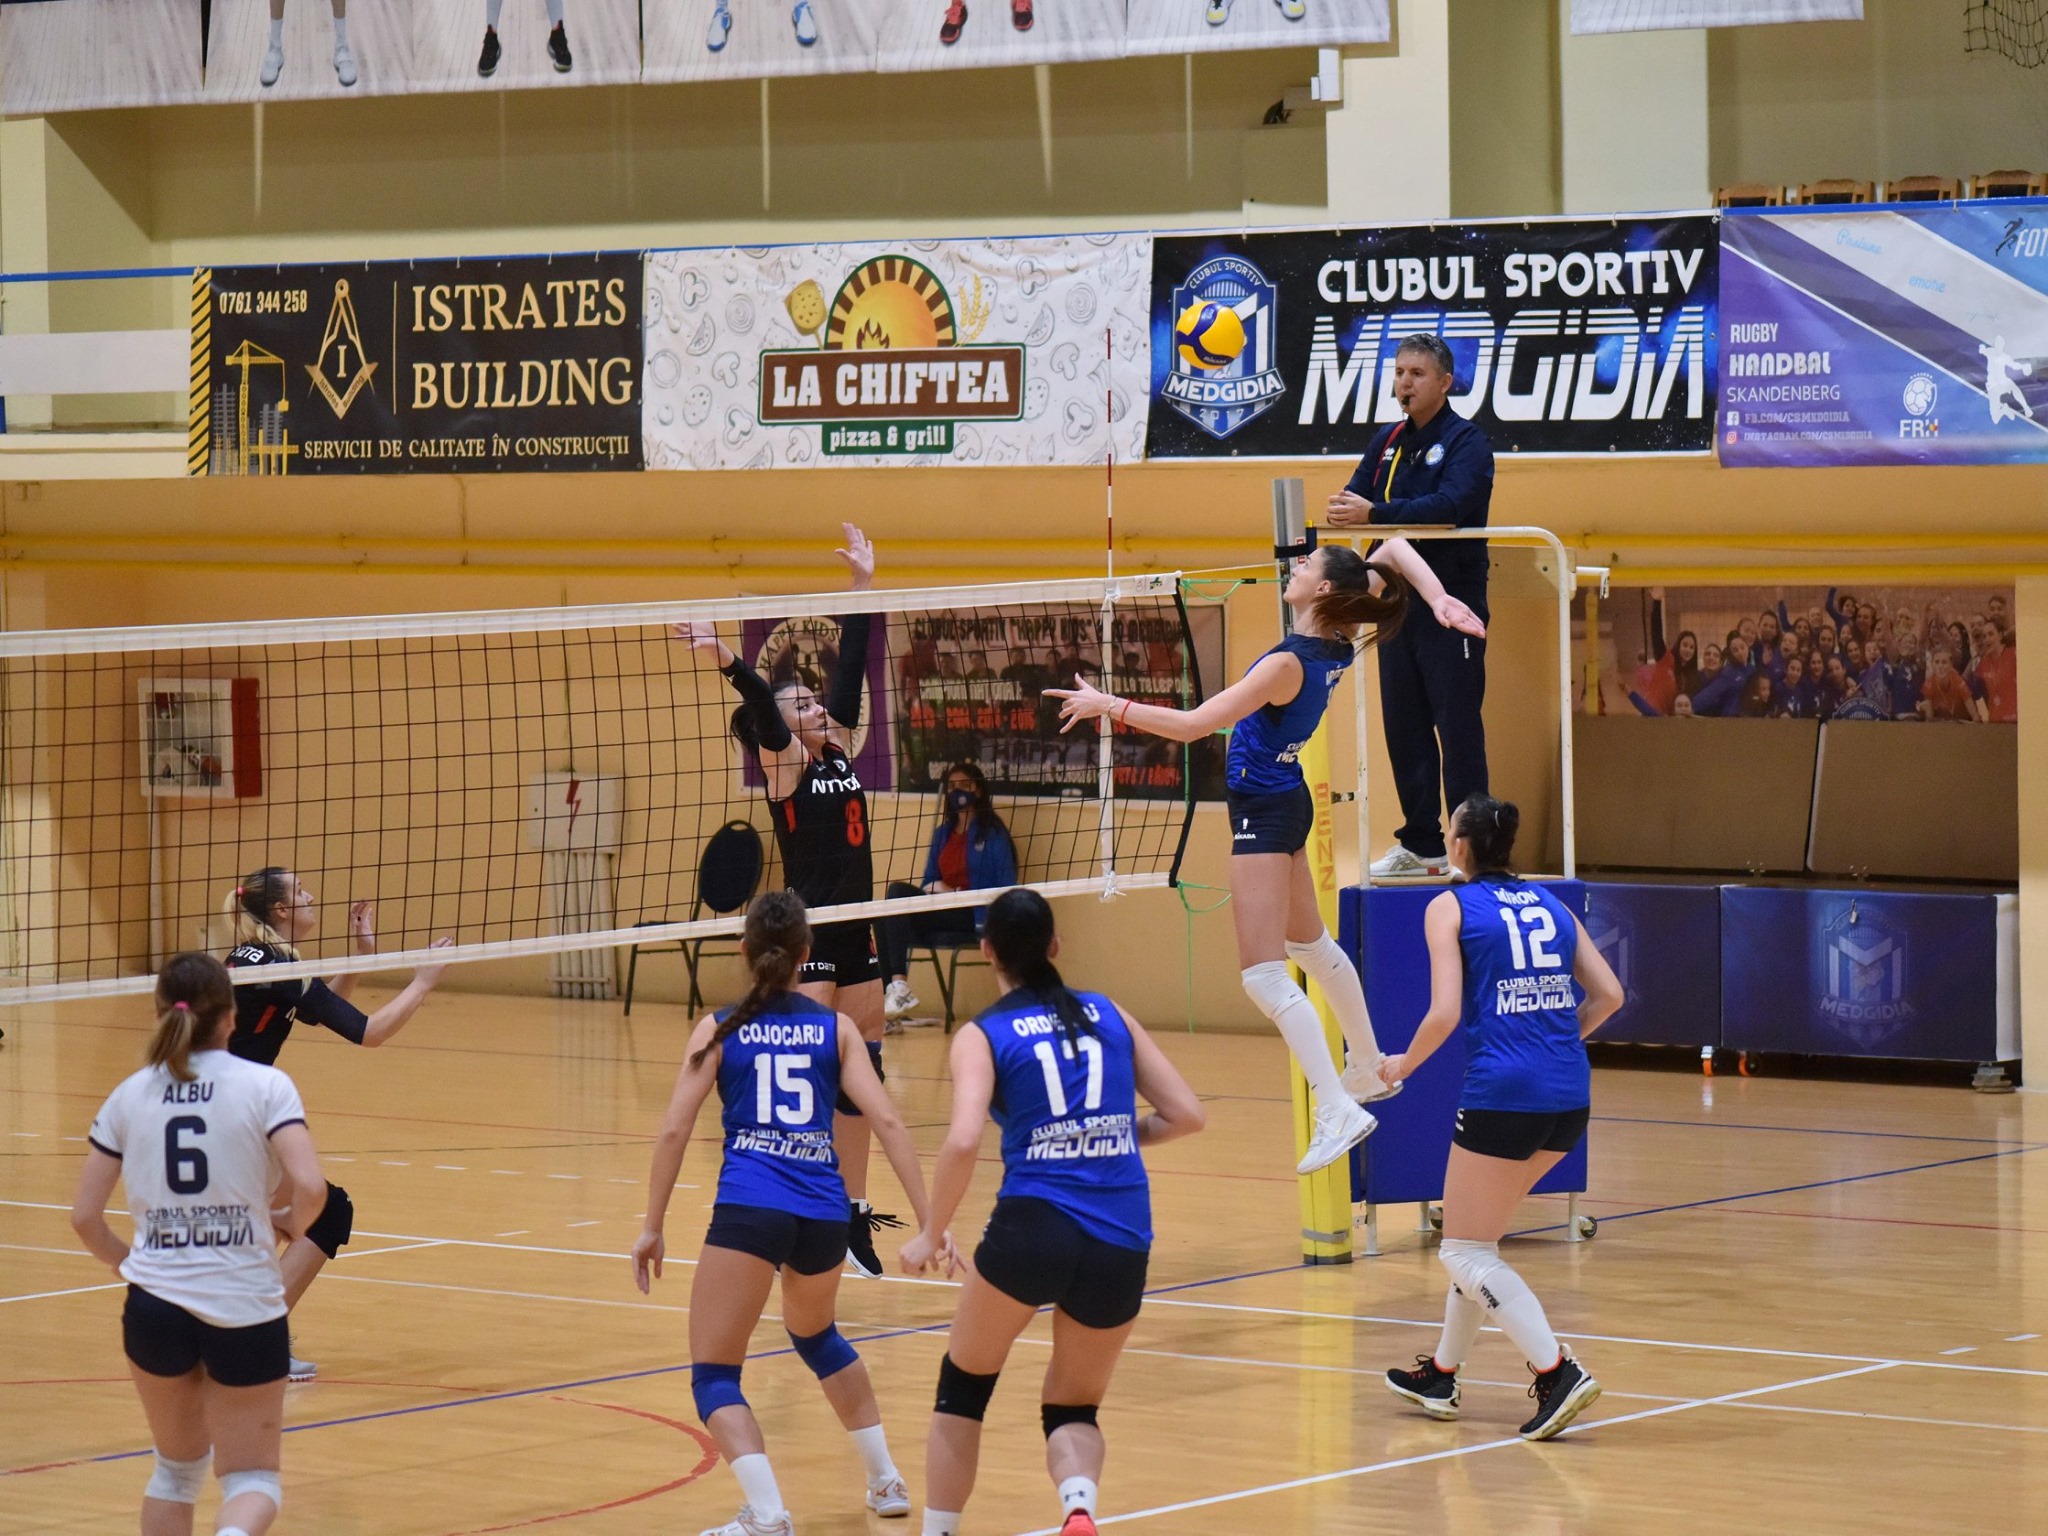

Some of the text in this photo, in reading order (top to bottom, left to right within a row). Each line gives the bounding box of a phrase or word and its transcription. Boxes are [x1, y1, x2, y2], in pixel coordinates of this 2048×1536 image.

[1189, 261, 1262, 290] CLUBUL SPORTIV
[1317, 248, 1704, 303] CLUBUL SPORTIV
[219, 290, 308, 314] 0761 344 258
[412, 278, 627, 332] ISTRATES
[1730, 322, 1779, 344] RUGBY
[1729, 352, 1831, 377] HANDBAL
[412, 357, 633, 409] BUILDING
[773, 360, 1010, 407] LA CHIFTEA
[1167, 373, 1282, 402] MEDGIDIA
[1727, 384, 1840, 403] SKANDENBERG
[1199, 408, 1245, 420] 2017
[304, 440, 372, 460] SERVICII
[379, 440, 403, 458] DE
[409, 438, 486, 458] CALITATE
[492, 434, 510, 456] ÎN
[829, 425, 946, 451] pizza & grill
[845, 798, 864, 848] 8
[1499, 906, 1562, 970] 12
[1496, 976, 1537, 990] CLUBUL
[738, 1022, 825, 1046] COJOCARU
[754, 1052, 814, 1125] 15
[1033, 1035, 1103, 1117] 17
[162, 1082, 214, 1104] ALBU
[165, 1115, 209, 1195] 6
